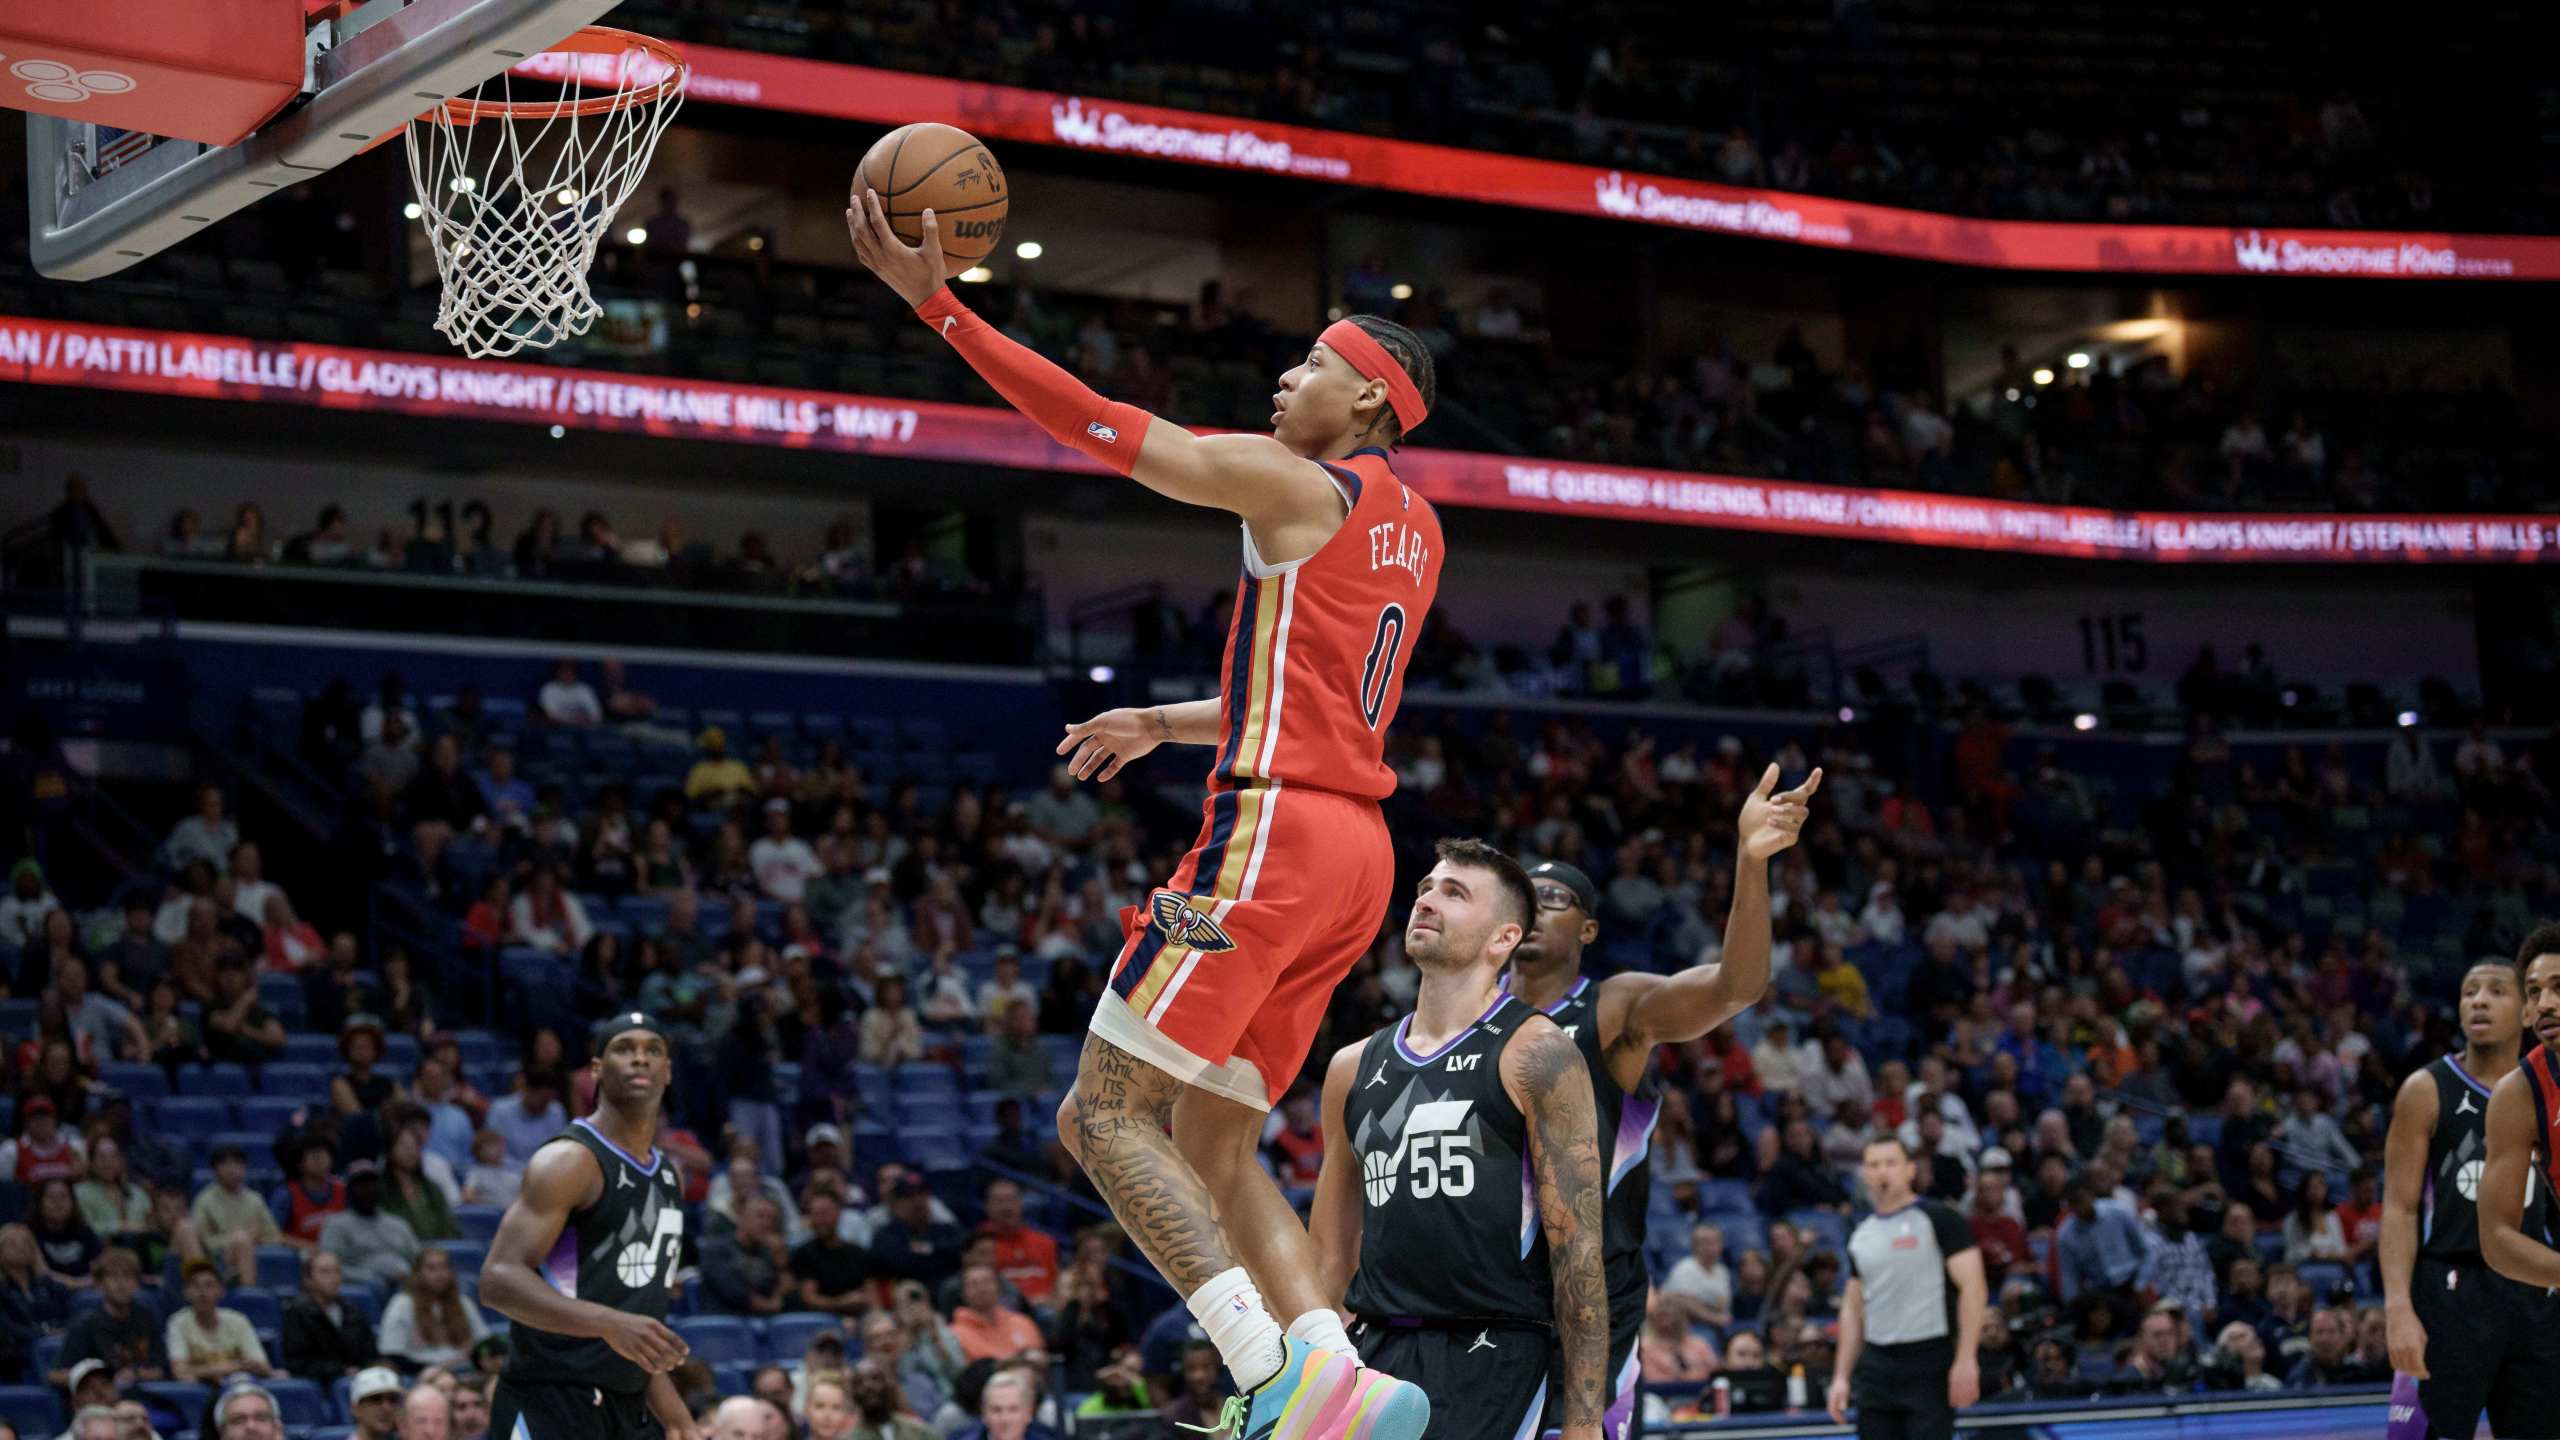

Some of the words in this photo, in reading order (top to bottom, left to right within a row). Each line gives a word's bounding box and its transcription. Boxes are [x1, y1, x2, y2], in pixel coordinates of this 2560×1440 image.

[1103, 113, 1224, 161] SMOOTHIE
[2281, 239, 2396, 272] SMOOTHIE
[64, 334, 157, 376] PATTI
[160, 342, 297, 388] LABELLE
[317, 357, 438, 400] GLADYS
[439, 369, 555, 410] KNIGHT
[573, 380, 733, 427] STEPHANIE
[734, 395, 820, 434] MILLS
[834, 404, 895, 439] MAY
[896, 409, 918, 443] 7
[1505, 464, 1550, 498] THE
[2153, 519, 2245, 551] GLADYS
[2246, 521, 2335, 549] KNIGHT
[2349, 521, 2475, 550] STEPHANIE
[2476, 522, 2543, 551] MILLS
[1369, 522, 1428, 588] FEARS
[1361, 602, 1406, 731] 0
[2077, 613, 2148, 673] 115
[1097, 1057, 1141, 1087] UNTIL
[1445, 1053, 1483, 1072] LVT
[1410, 1135, 1475, 1200] 55
